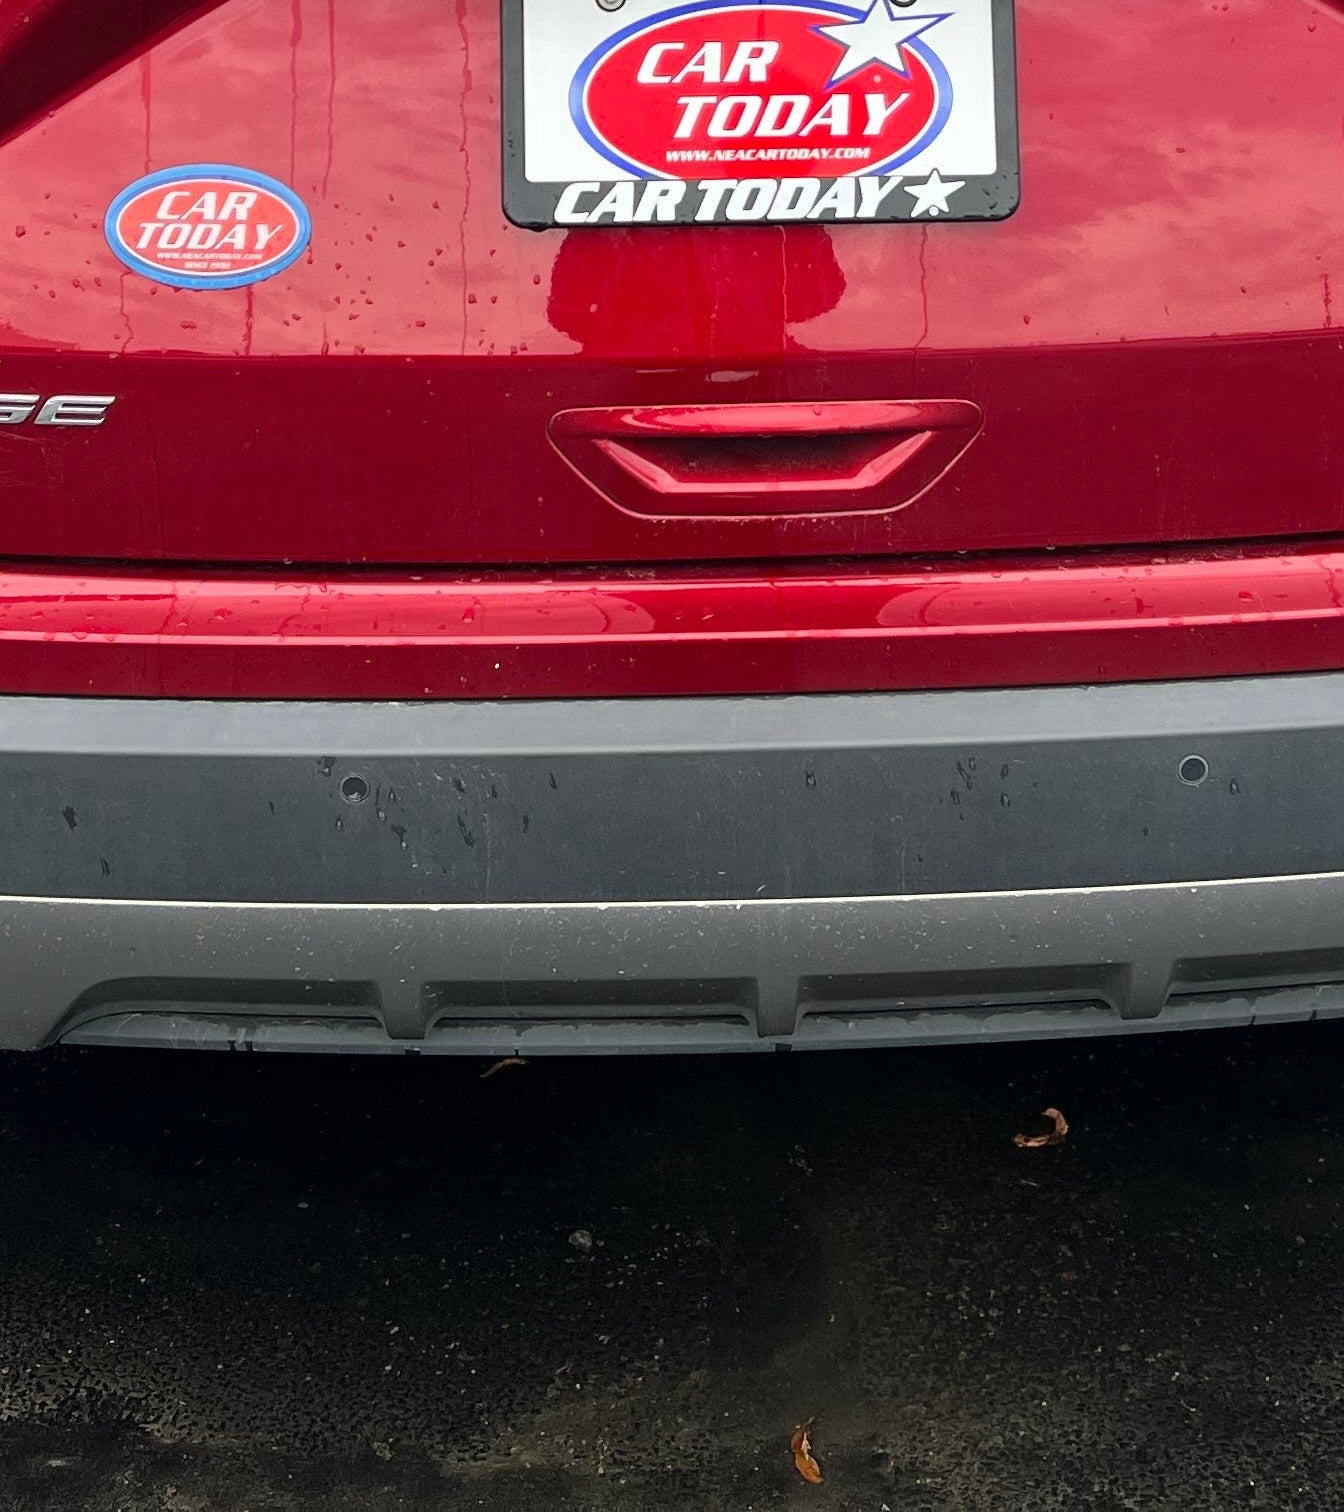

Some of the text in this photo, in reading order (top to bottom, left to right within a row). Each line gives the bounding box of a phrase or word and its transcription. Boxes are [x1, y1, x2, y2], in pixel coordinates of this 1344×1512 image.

[637, 40, 779, 84] CAR
[672, 93, 910, 138] TODAY
[665, 147, 871, 162] WWW.NEACARTODAY.COM
[156, 191, 257, 221] CAR
[555, 175, 905, 223] CAR TODAY
[136, 222, 284, 250] TODAY
